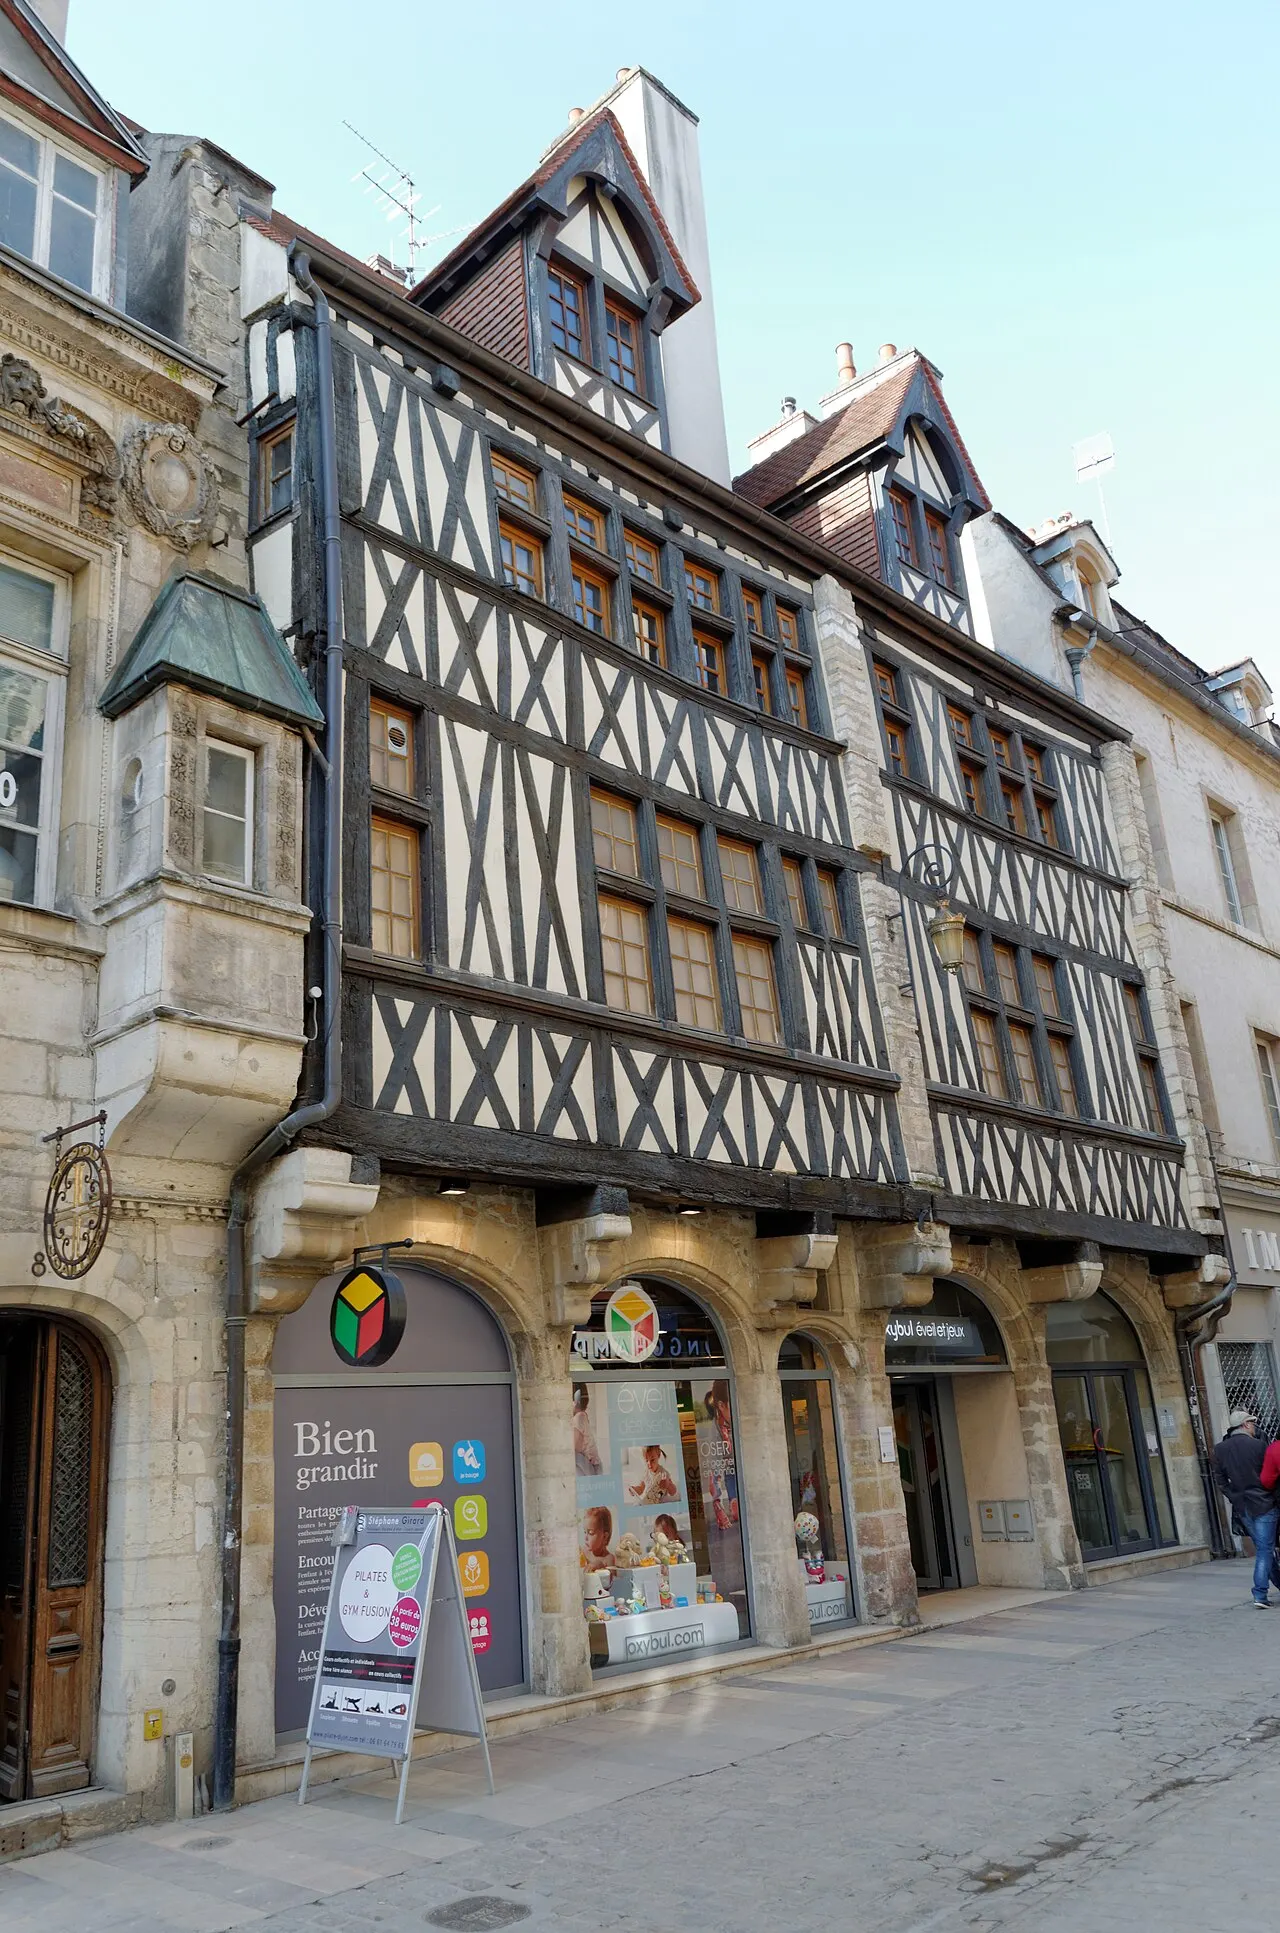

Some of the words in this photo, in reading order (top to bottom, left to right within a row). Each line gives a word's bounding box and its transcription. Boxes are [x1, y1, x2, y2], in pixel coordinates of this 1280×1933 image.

[886, 1320, 914, 1341] xybul
[293, 1420, 378, 1457] Bien
[701, 1441, 730, 1457] OSER
[296, 1457, 378, 1491] grandir
[298, 1506, 343, 1521] Partage
[368, 1515, 400, 1527] Stéphane
[402, 1515, 425, 1525] Girard
[298, 1555, 335, 1569] Encou
[355, 1571, 388, 1583] PILATES
[364, 1589, 369, 1599] &
[298, 1603, 329, 1620] Déve
[342, 1604, 359, 1616] GYM
[361, 1605, 391, 1618] FUSION
[400, 1608, 413, 1618] partir
[413, 1610, 421, 1620] de
[391, 1616, 401, 1628] 38
[401, 1621, 420, 1634] euros
[627, 1629, 704, 1656] oxybul.com
